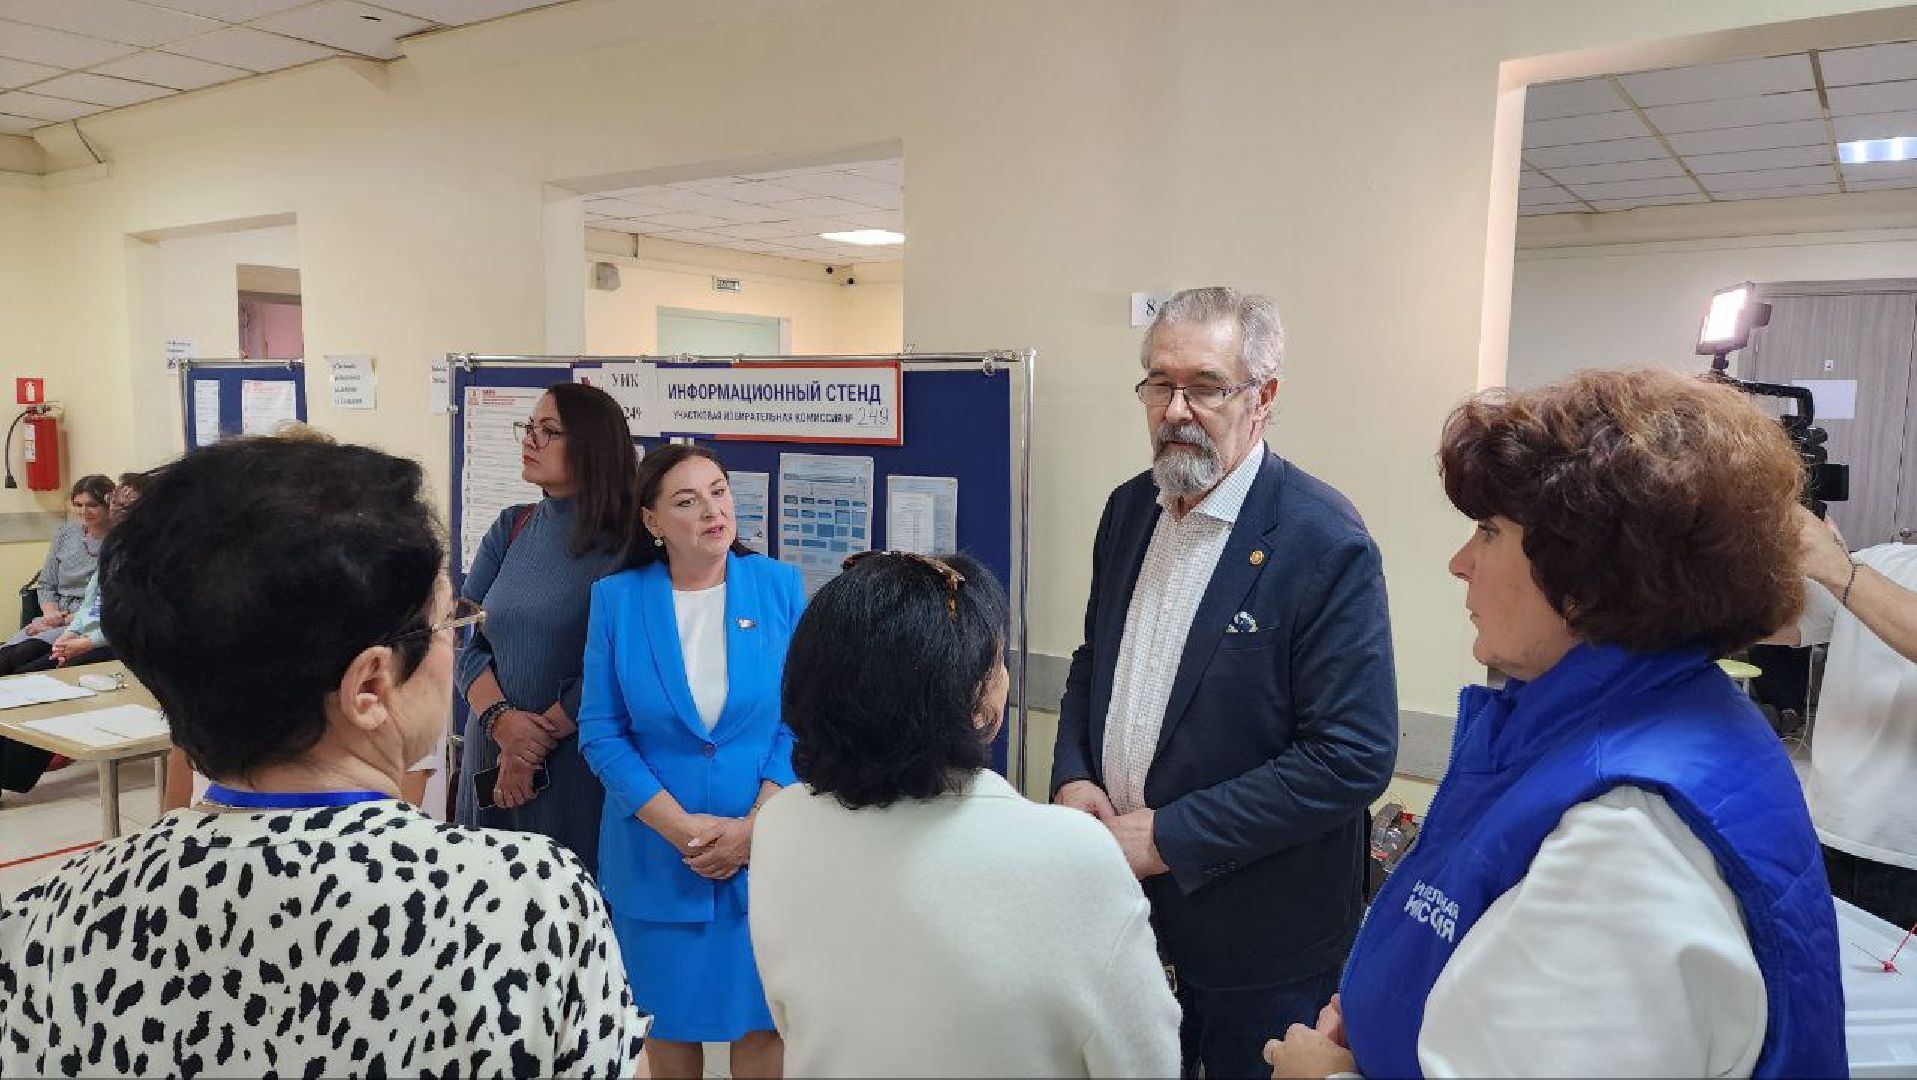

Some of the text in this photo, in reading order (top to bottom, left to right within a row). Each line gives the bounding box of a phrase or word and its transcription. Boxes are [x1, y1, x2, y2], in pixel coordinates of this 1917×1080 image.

[668, 379, 881, 405] ИНФОРМАЦИОННЫЙ СТЕНД
[673, 410, 721, 420] УЧАСТКОВАЯ
[723, 410, 793, 422] ИЗБИРАТЕЛЬНАЯ
[795, 412, 842, 423] КОМИССИЯ
[857, 406, 889, 426] 249
